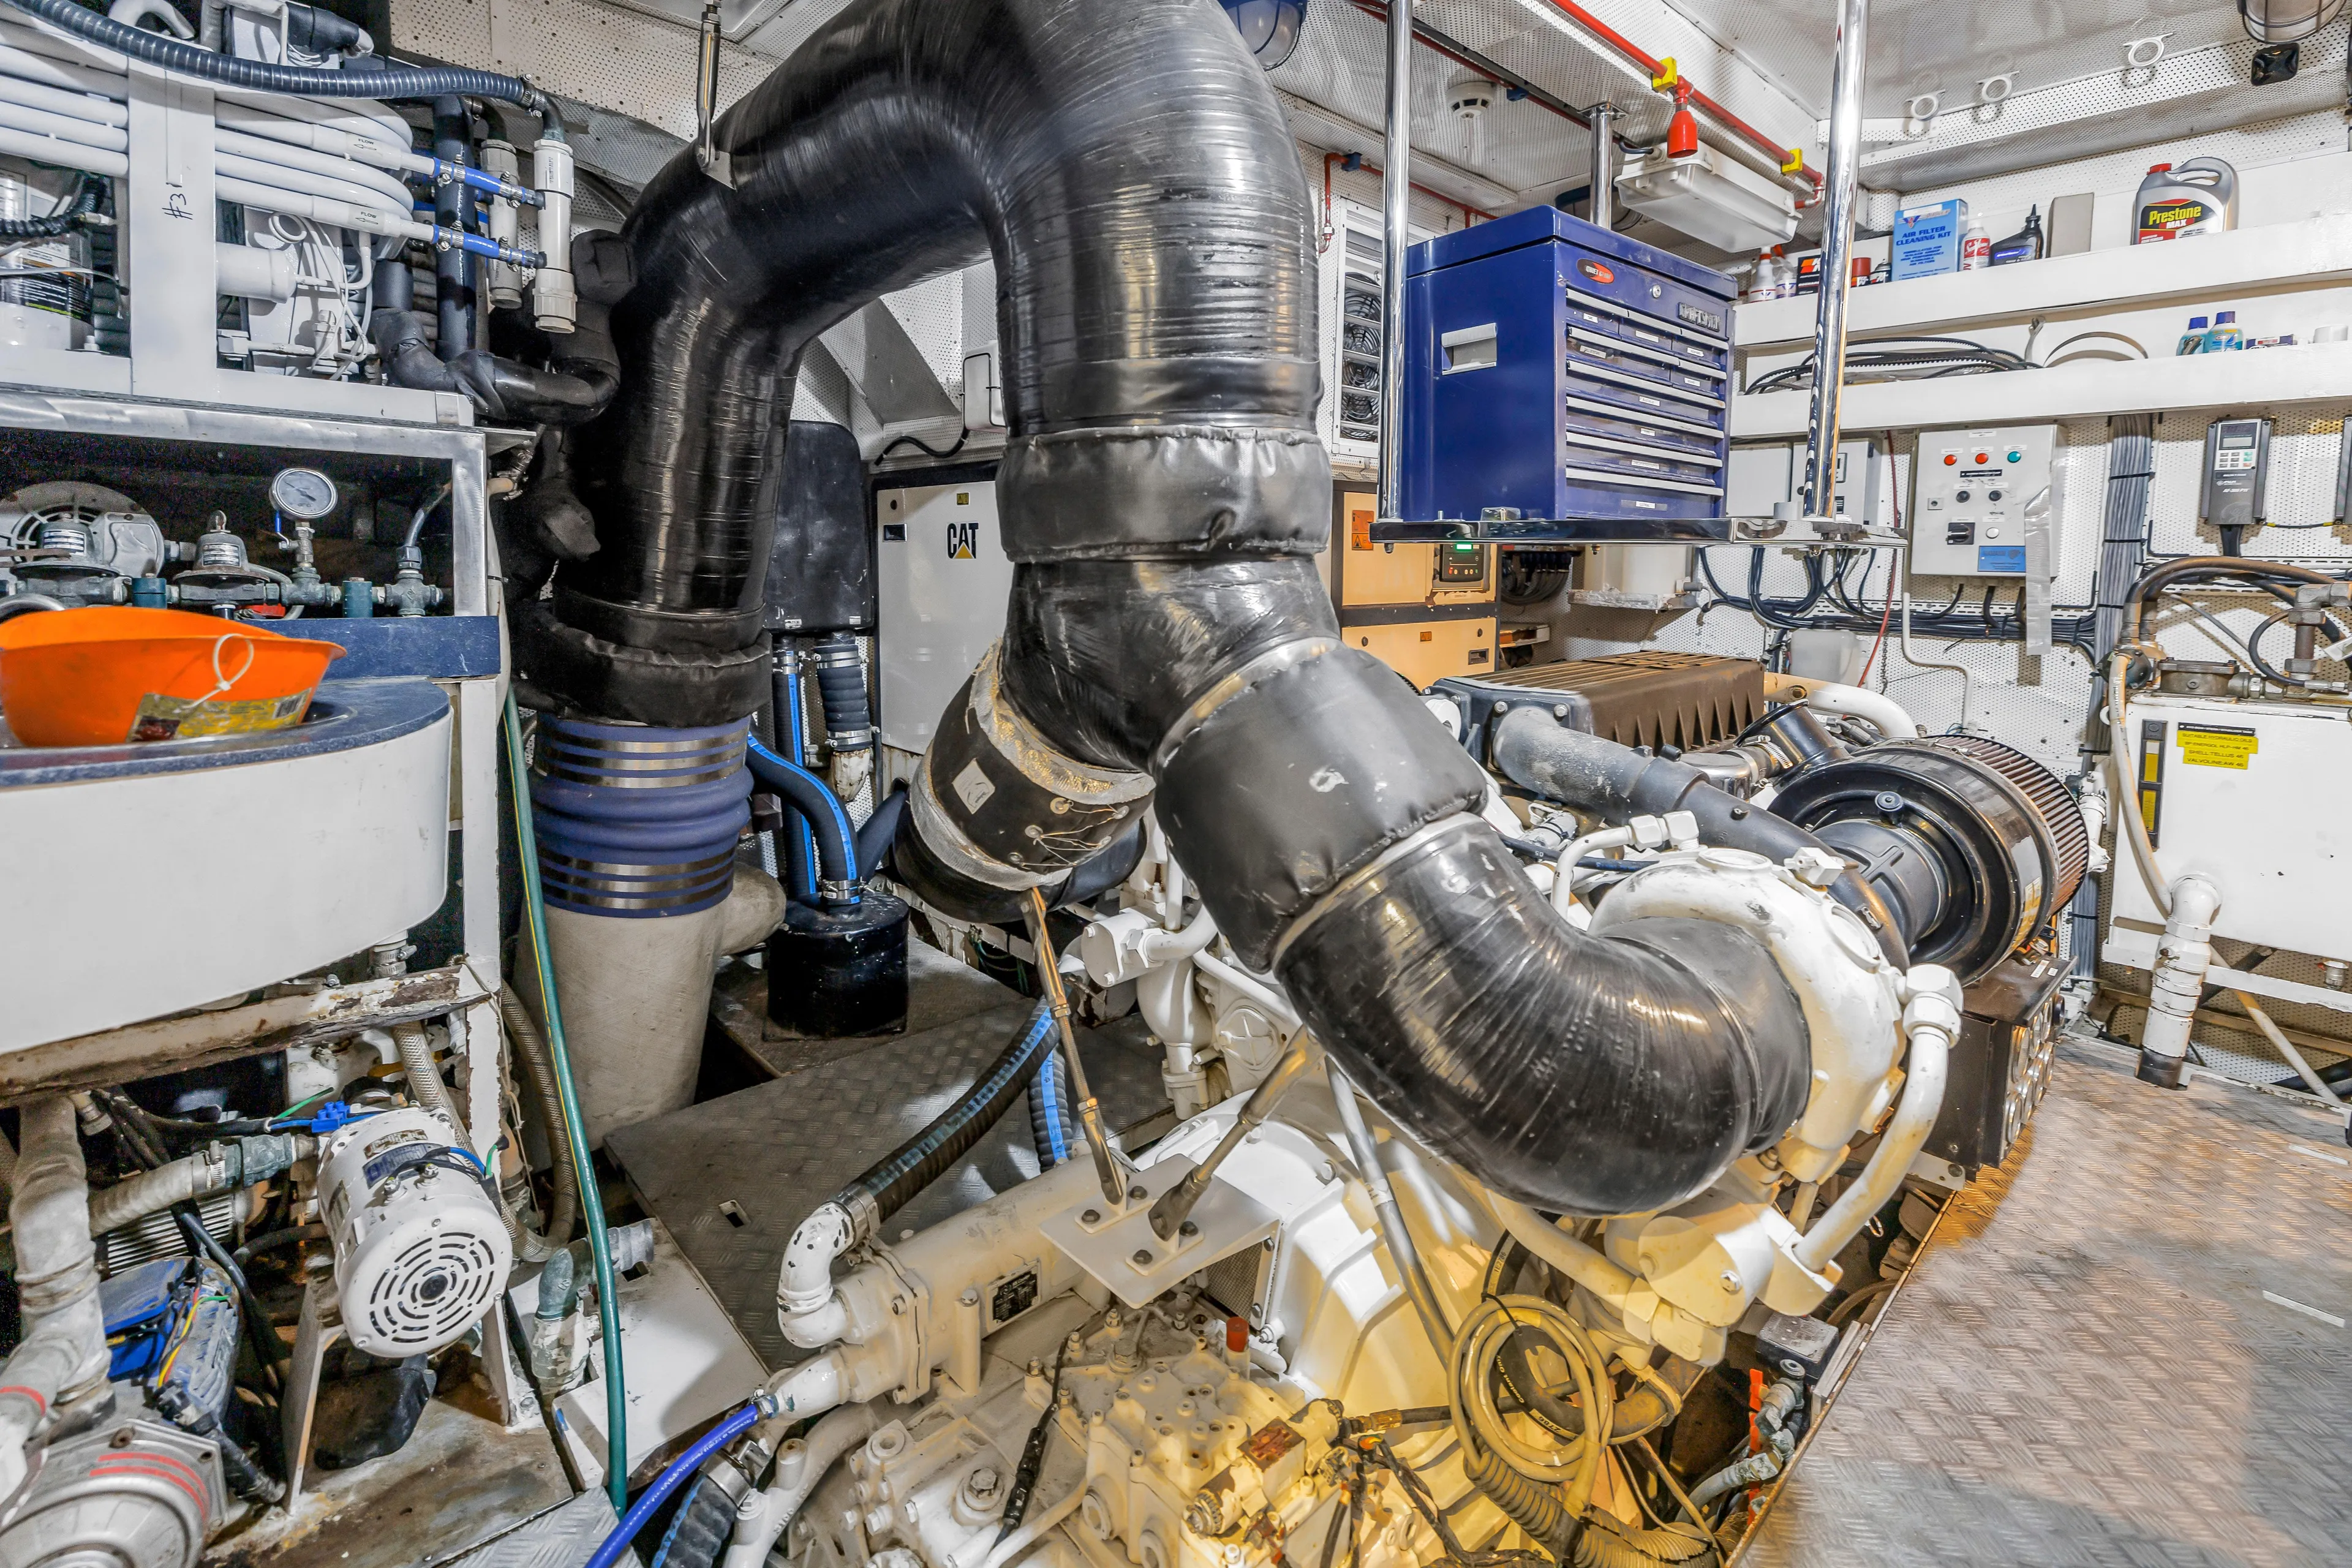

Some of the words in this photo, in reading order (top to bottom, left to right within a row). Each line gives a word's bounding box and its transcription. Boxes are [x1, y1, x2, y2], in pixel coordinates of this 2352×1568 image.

[162, 194, 193, 220] #3
[2149, 206, 2202, 225] Prestone
[1919, 225, 1946, 236] FILTER
[2166, 219, 2187, 229] MAX
[1896, 234, 1936, 246] CLEANING
[1585, 265, 1599, 275] QUIET
[947, 522, 979, 559] CAT
[1496, 1354, 1505, 1373] Only
[1503, 1374, 1525, 1403] Coolant
